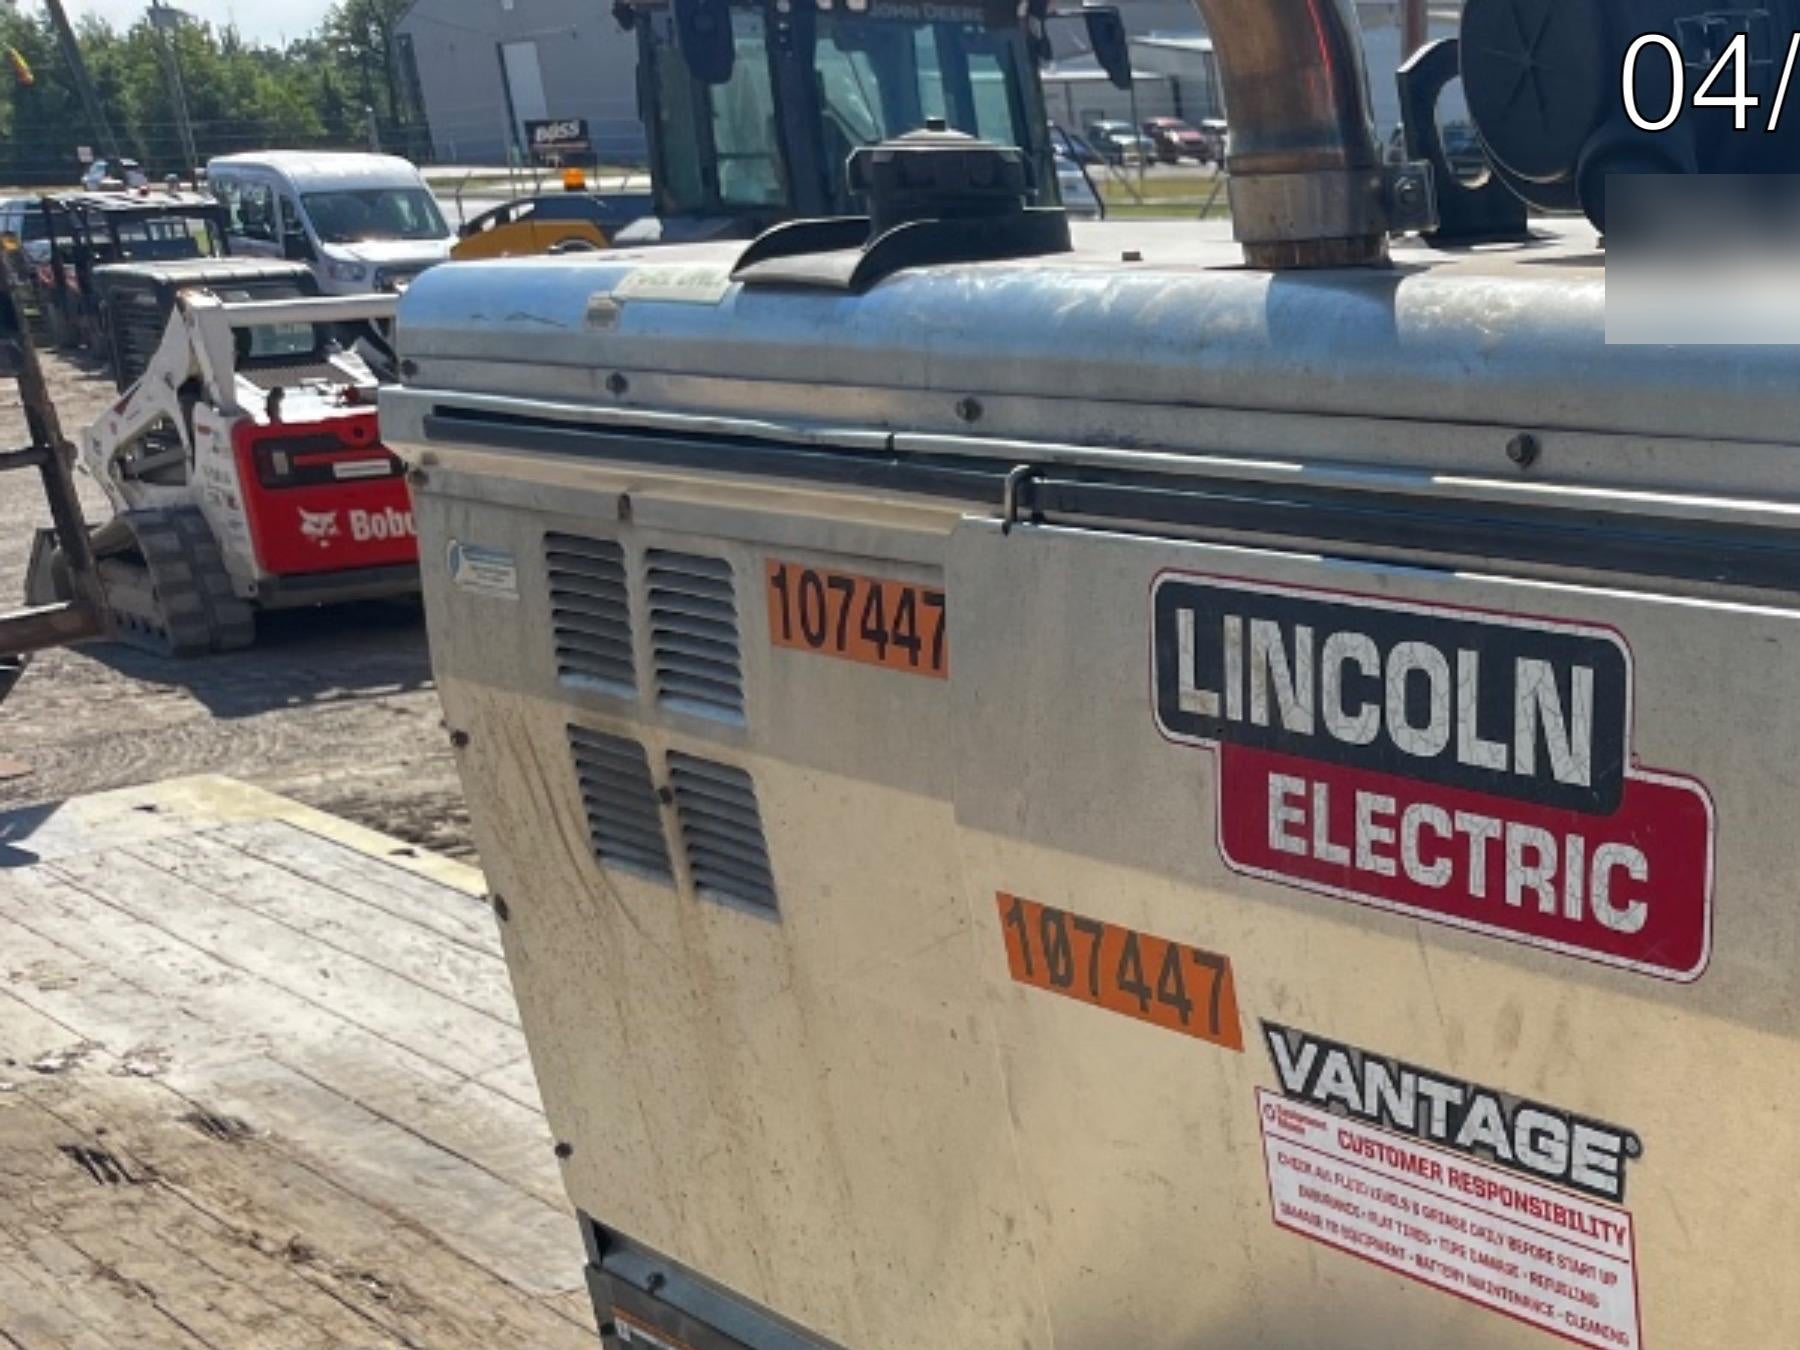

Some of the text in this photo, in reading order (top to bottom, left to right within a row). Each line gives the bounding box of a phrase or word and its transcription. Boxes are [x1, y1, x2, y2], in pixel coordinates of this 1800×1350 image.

[770, 562, 946, 671] 107447
[1176, 607, 1595, 788] LINCOLN
[1267, 770, 1649, 935] ELECTRIC
[1007, 896, 1228, 1037] 107447
[1268, 1030, 1622, 1196] VANTAGE
[1338, 1127, 1627, 1247] CUSTOMER RESPONSIBILITY
[1505, 1233, 1554, 1266] BEFORE
[1555, 1251, 1596, 1281] START
[1563, 1308, 1630, 1349] CLEANING
